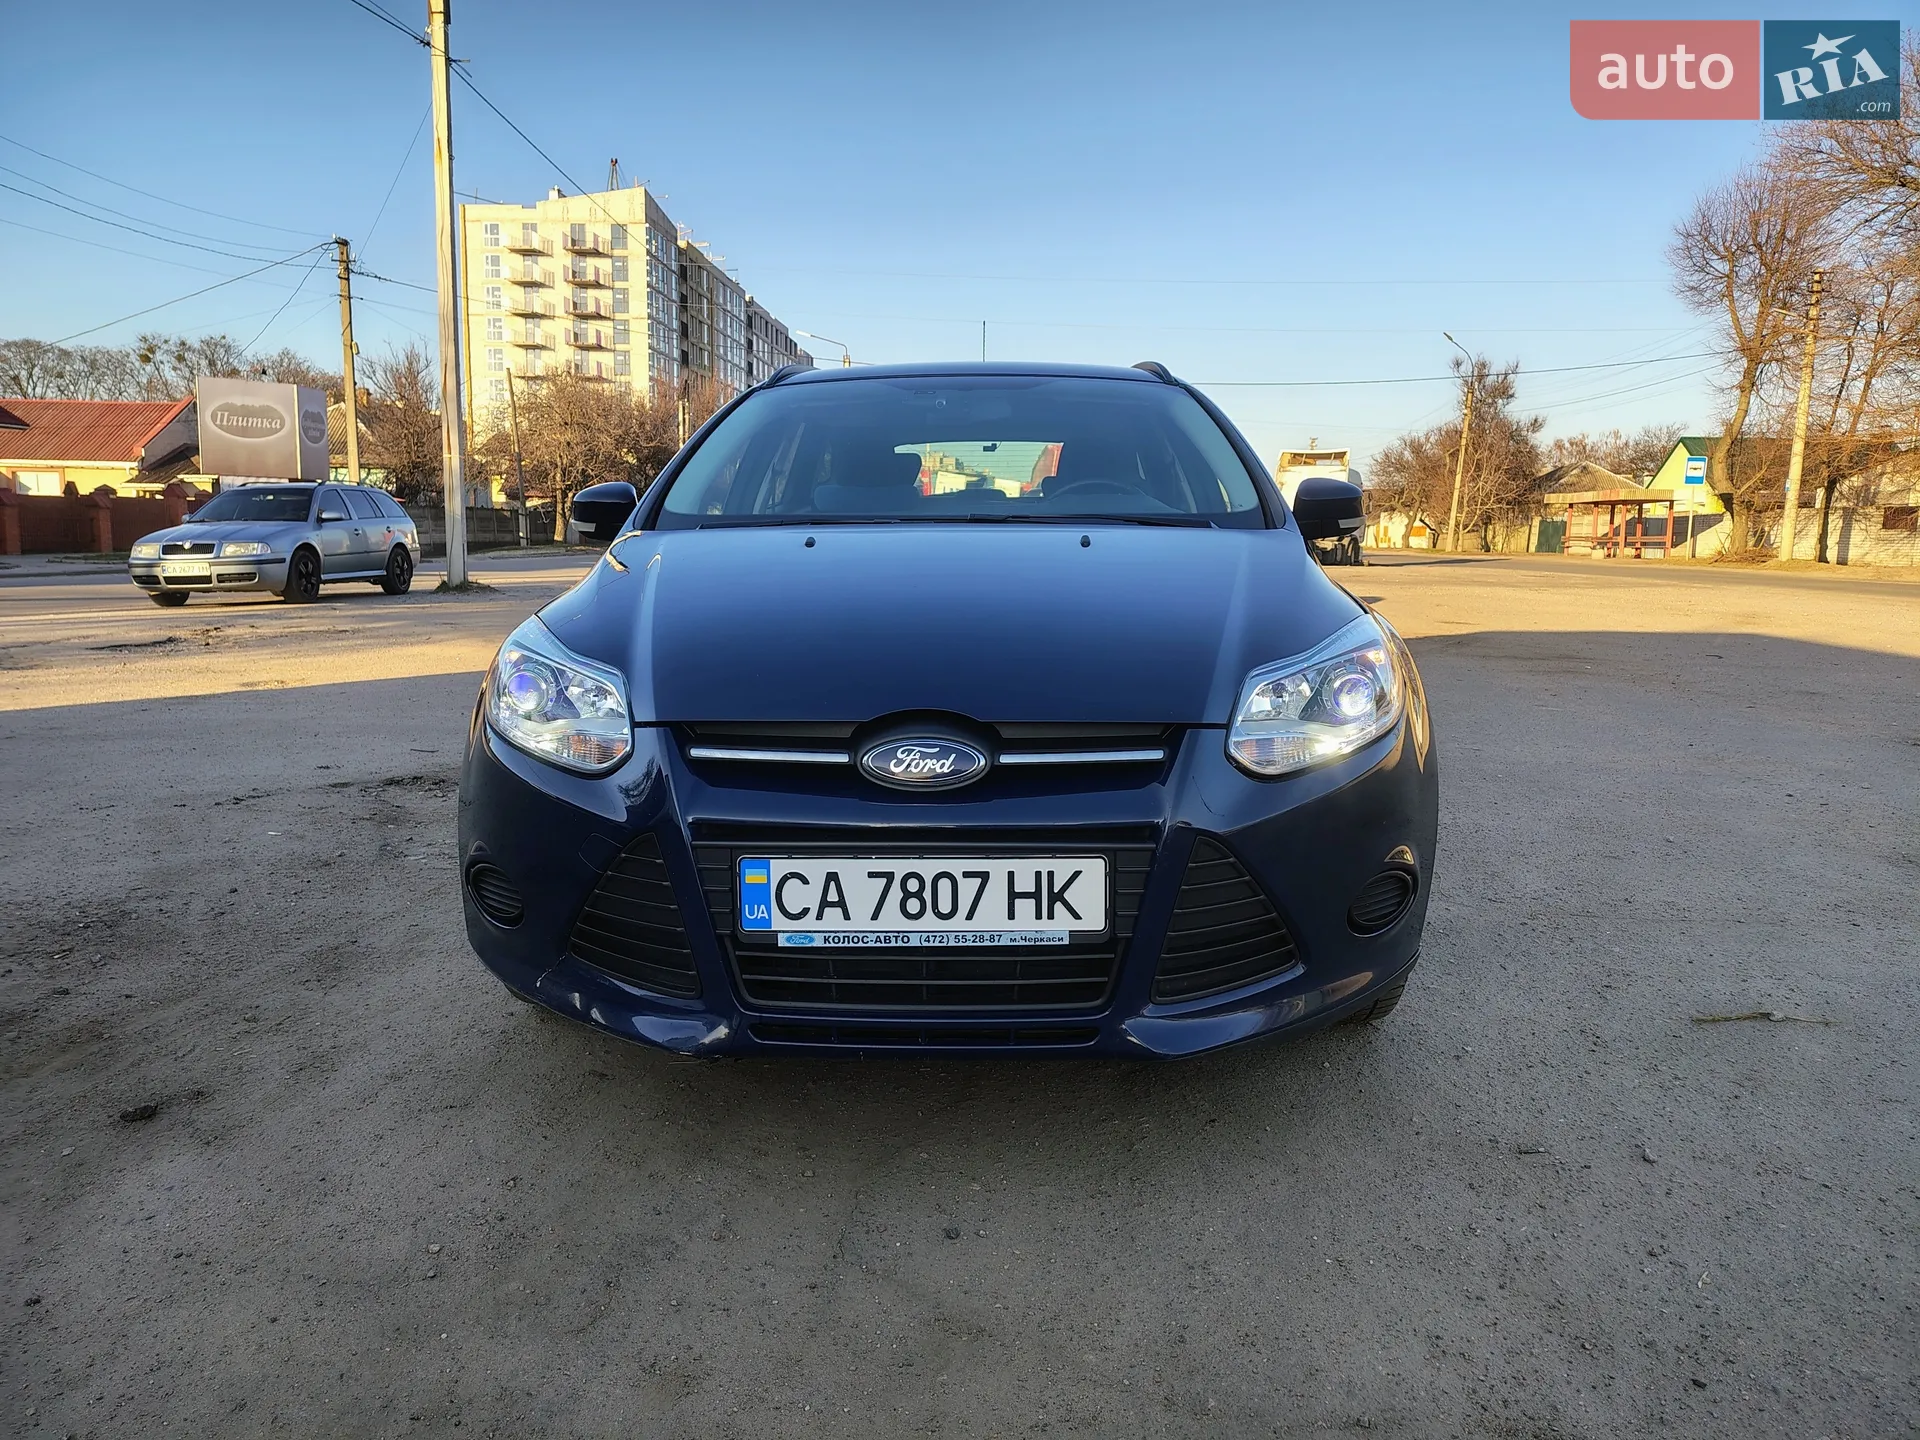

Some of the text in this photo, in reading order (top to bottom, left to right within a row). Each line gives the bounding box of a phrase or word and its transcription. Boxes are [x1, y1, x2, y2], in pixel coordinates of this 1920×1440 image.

[215, 410, 282, 429] Плитка
[889, 745, 957, 774] Ford
[774, 869, 1084, 921] CA 7807 HK
[744, 904, 770, 920] UA
[789, 934, 810, 945] Ford
[823, 934, 1064, 946] КОЛОС-АВТО (472) 55-28-87 м.Черкаси
